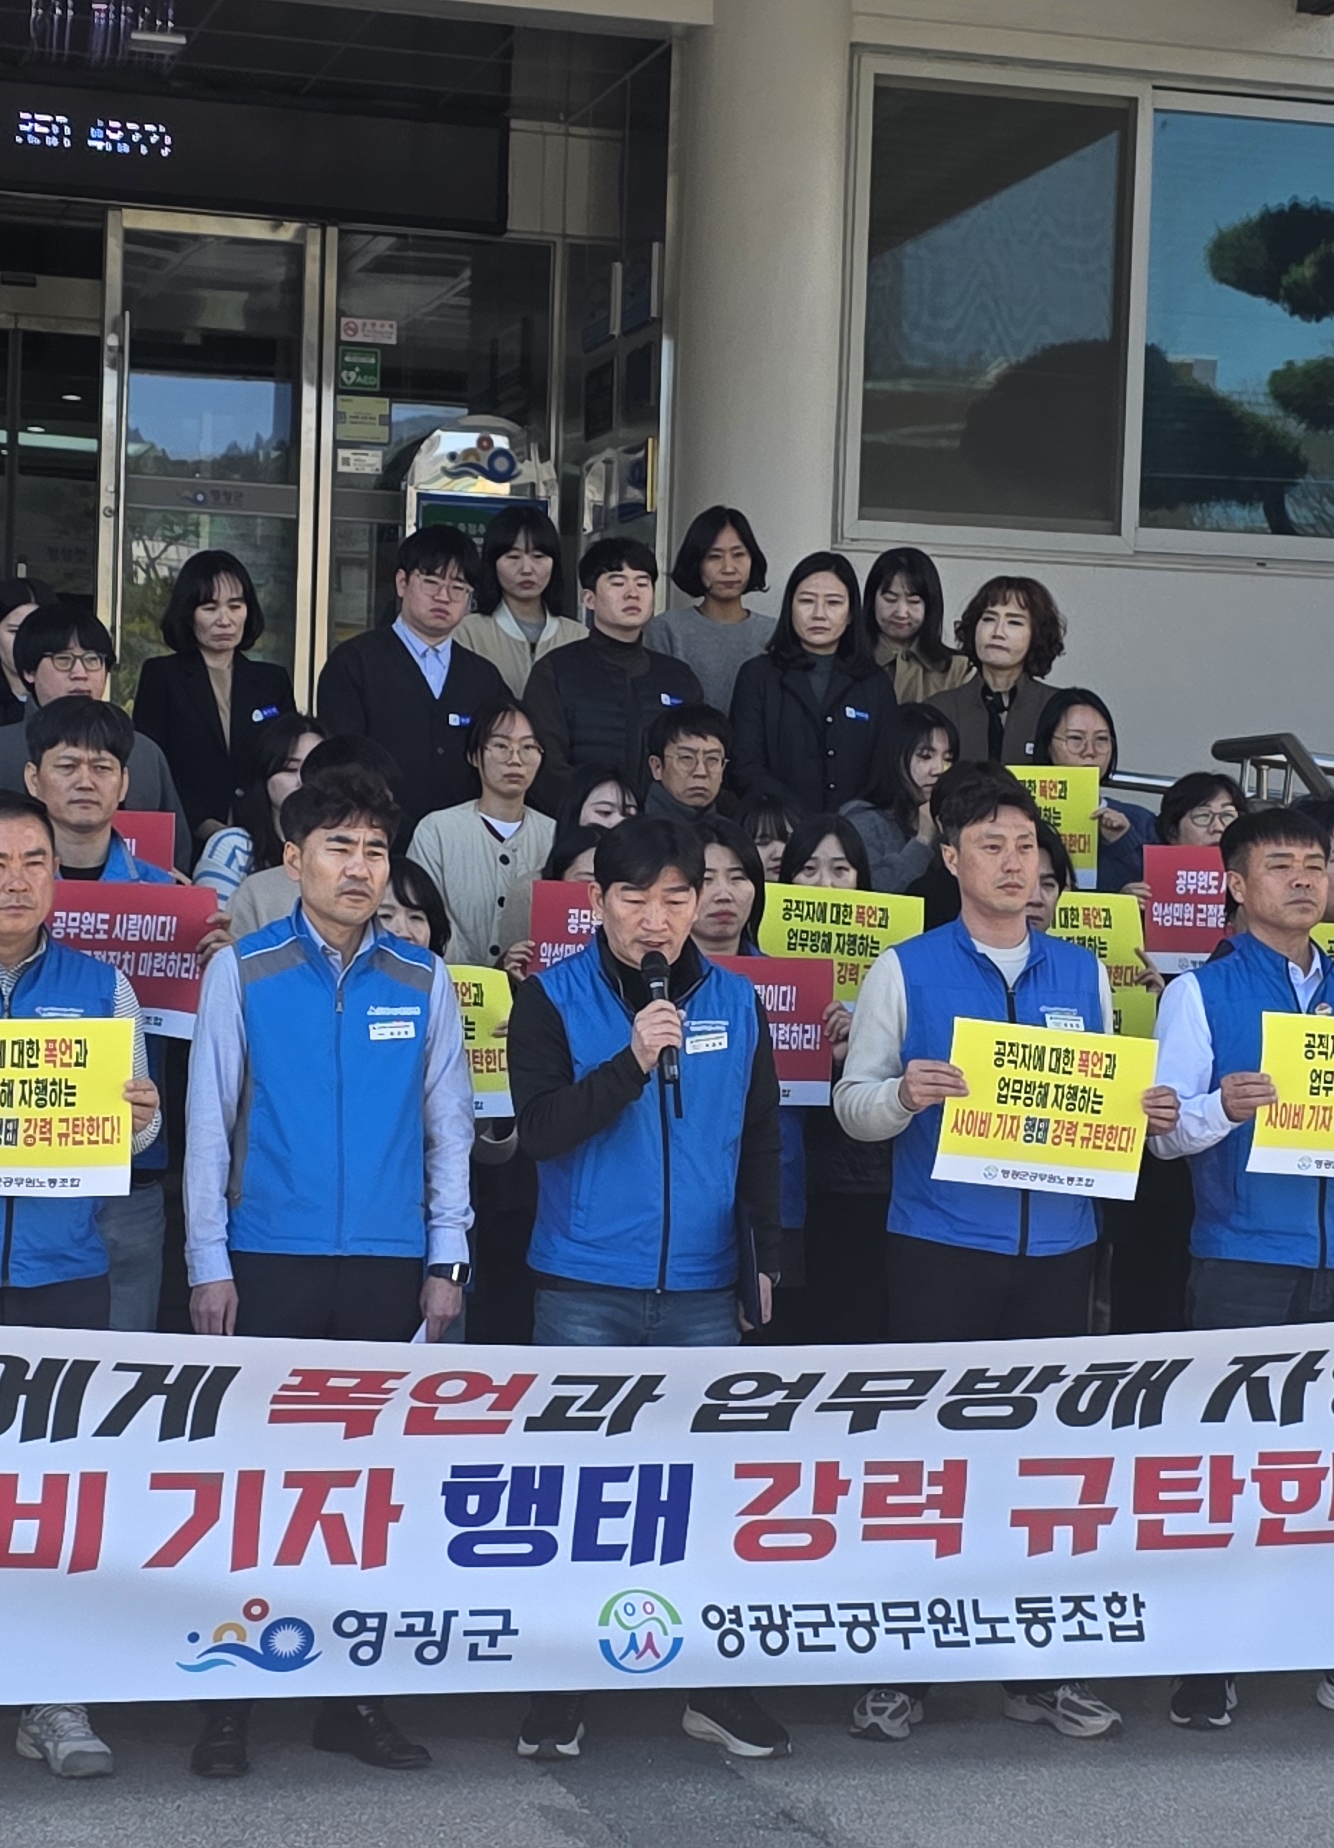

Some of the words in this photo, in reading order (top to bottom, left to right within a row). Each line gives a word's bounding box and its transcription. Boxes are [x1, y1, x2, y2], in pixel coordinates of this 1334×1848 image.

[355, 374, 377, 386] AED
[1175, 870, 1220, 895] 공무원도
[52, 911, 110, 939] 공무원도
[112, 913, 177, 941] 사람이다!
[782, 899, 827, 924] 공직자에
[830, 902, 852, 925] 대한
[855, 904, 889, 929] 폭언과
[1058, 906, 1080, 929] 대한
[1082, 906, 1112, 929] 폭언과
[1152, 902, 1194, 926] 악성민원
[787, 928, 832, 954] 업무방해
[834, 932, 880, 957] 자행하는
[836, 961, 859, 985] 강력
[10, 1039, 41, 1070] 대한
[43, 1038, 89, 1070] 폭언과
[993, 1039, 1046, 1074] 공직자에
[1048, 1045, 1075, 1077] 대한
[1077, 1049, 1117, 1081] 폭언과
[18, 1078, 78, 1110] 자행하는
[997, 1077, 1048, 1111] 업무방해
[1051, 1082, 1105, 1116] 자행하는
[22, 1115, 53, 1147] 강력
[57, 1114, 122, 1147] 규탄한다!
[950, 1107, 991, 1140] 사이비
[993, 1111, 1019, 1143] 기자
[1022, 1114, 1049, 1145] 행태
[1052, 1117, 1078, 1148] 강력
[1080, 1121, 1136, 1154] 규탄한다!
[1264, 1102, 1305, 1131] 사이비
[1307, 1104, 1333, 1132] 기자
[268, 1368, 666, 1440] 폭언과
[690, 1357, 1193, 1436] 업무방해
[141, 1467, 404, 1572] 기자
[441, 1463, 694, 1568] 행태
[733, 1458, 970, 1562] 강력
[332, 1608, 520, 1667] 영광군
[701, 1591, 1147, 1658] 영광군공무원노동조합
